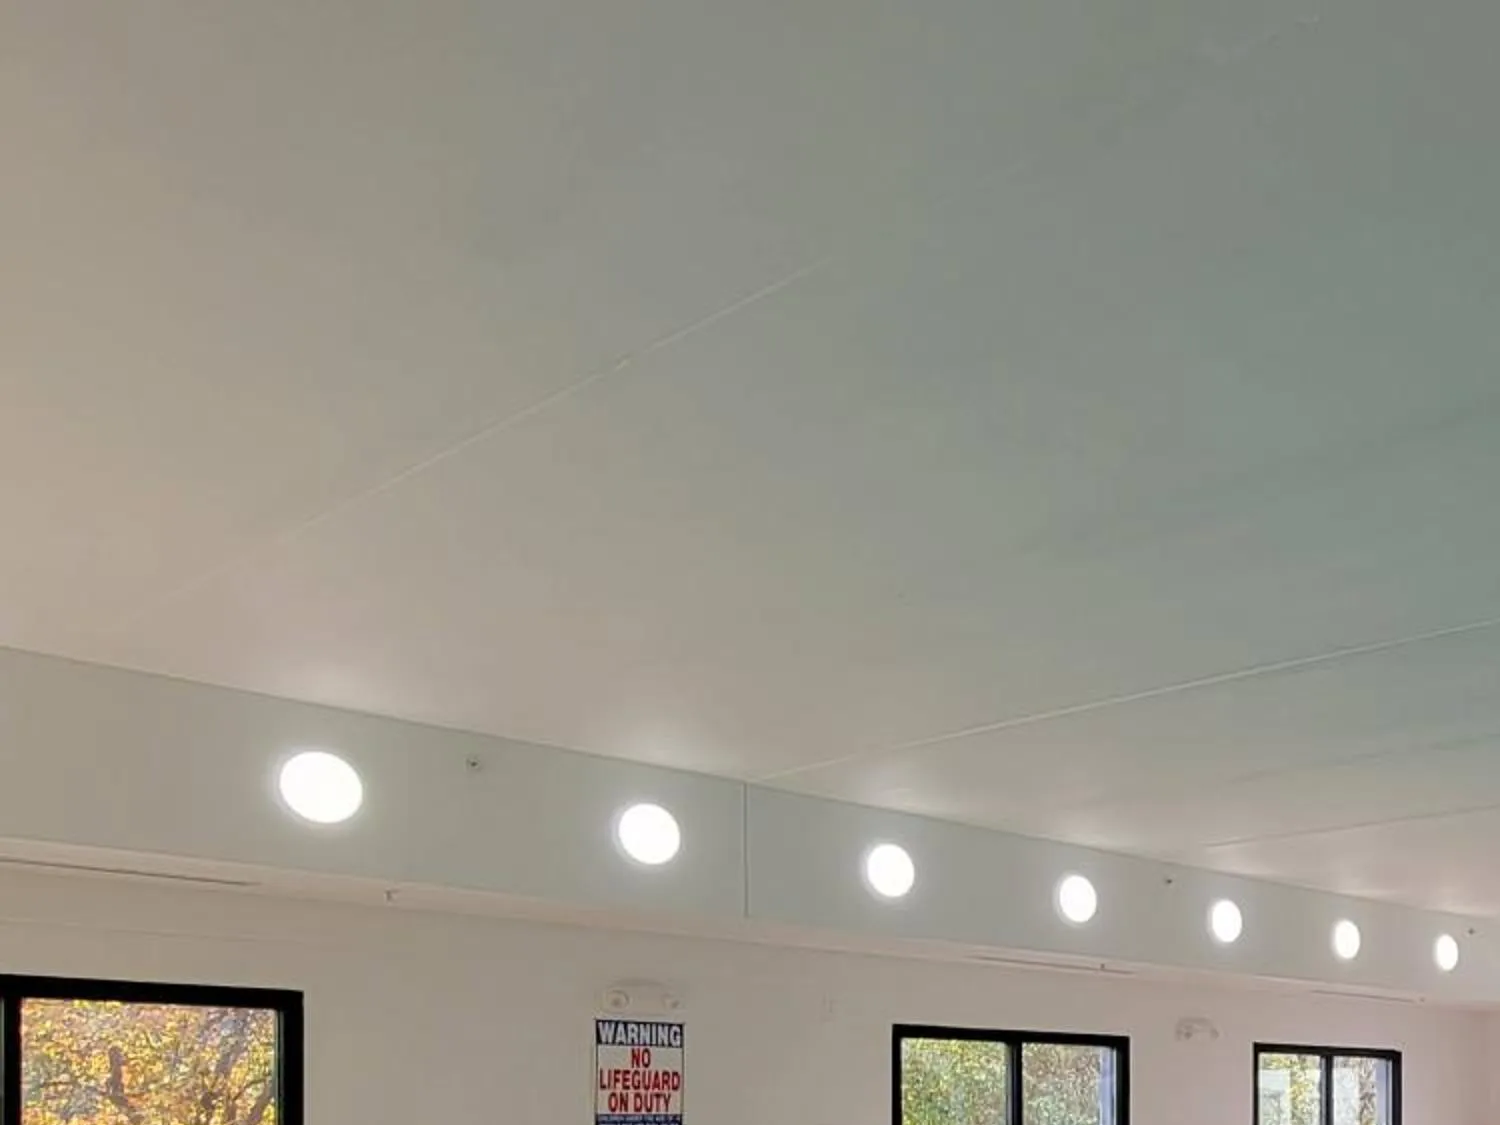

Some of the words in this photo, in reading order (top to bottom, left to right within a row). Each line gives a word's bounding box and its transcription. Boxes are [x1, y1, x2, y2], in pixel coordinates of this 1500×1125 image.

[598, 1021, 681, 1047] WARNING
[631, 1048, 651, 1068] NO
[600, 1069, 681, 1091] LIFEGUARD
[608, 1092, 629, 1112] ON
[634, 1093, 672, 1112] DUTY
